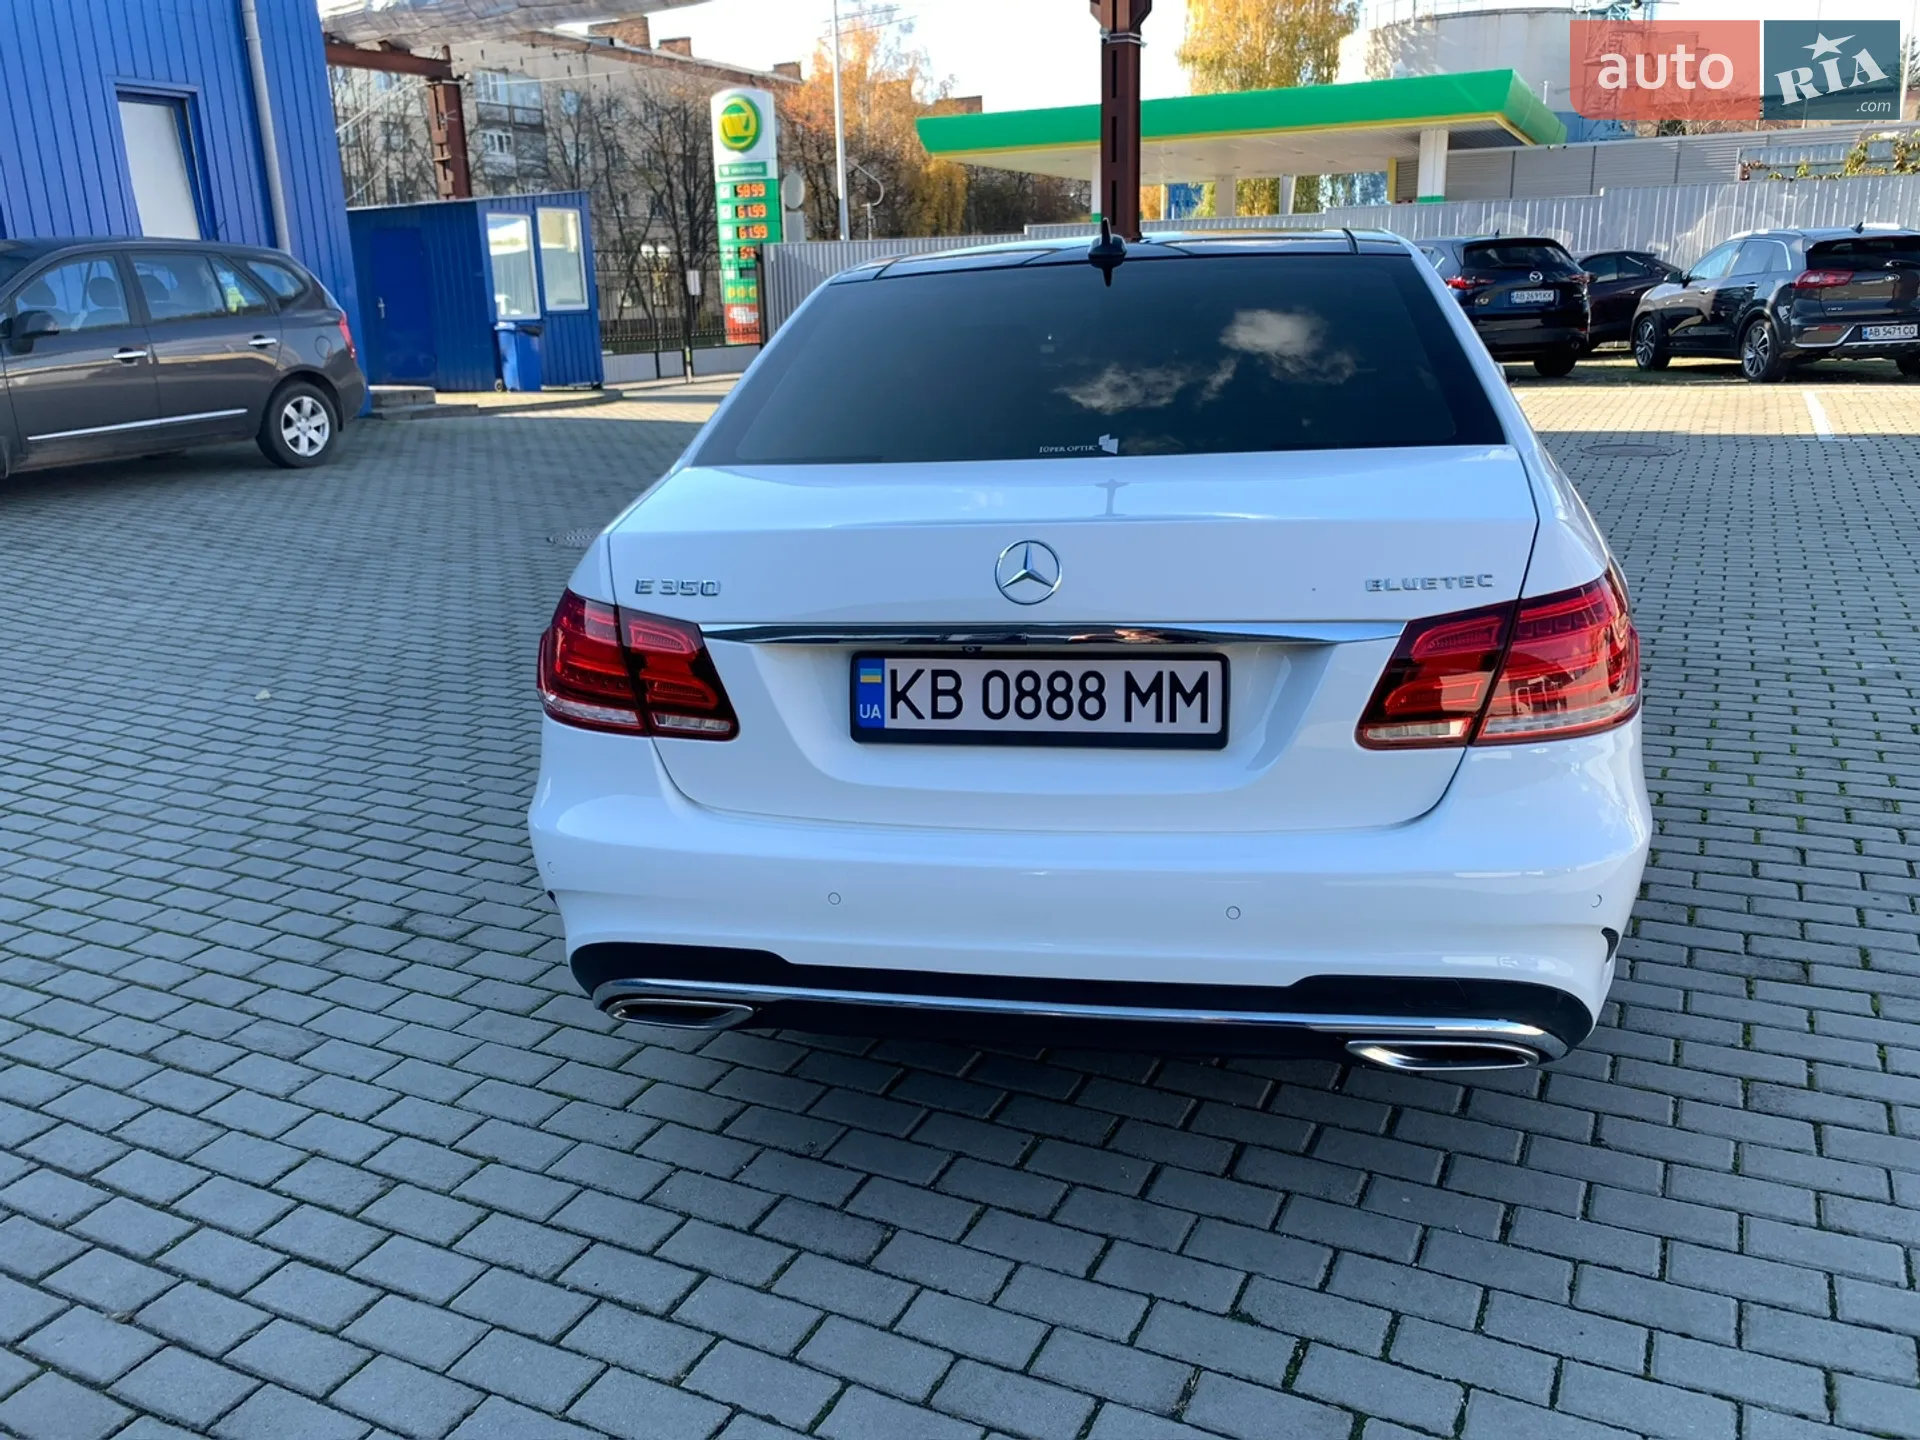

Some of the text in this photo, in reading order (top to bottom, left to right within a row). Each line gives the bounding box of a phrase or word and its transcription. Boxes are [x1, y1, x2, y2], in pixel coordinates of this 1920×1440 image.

[635, 578, 721, 596] E 350
[1365, 573, 1494, 592] BLUETEC
[889, 668, 1209, 723] KB 0888 MM
[859, 703, 881, 719] UA
